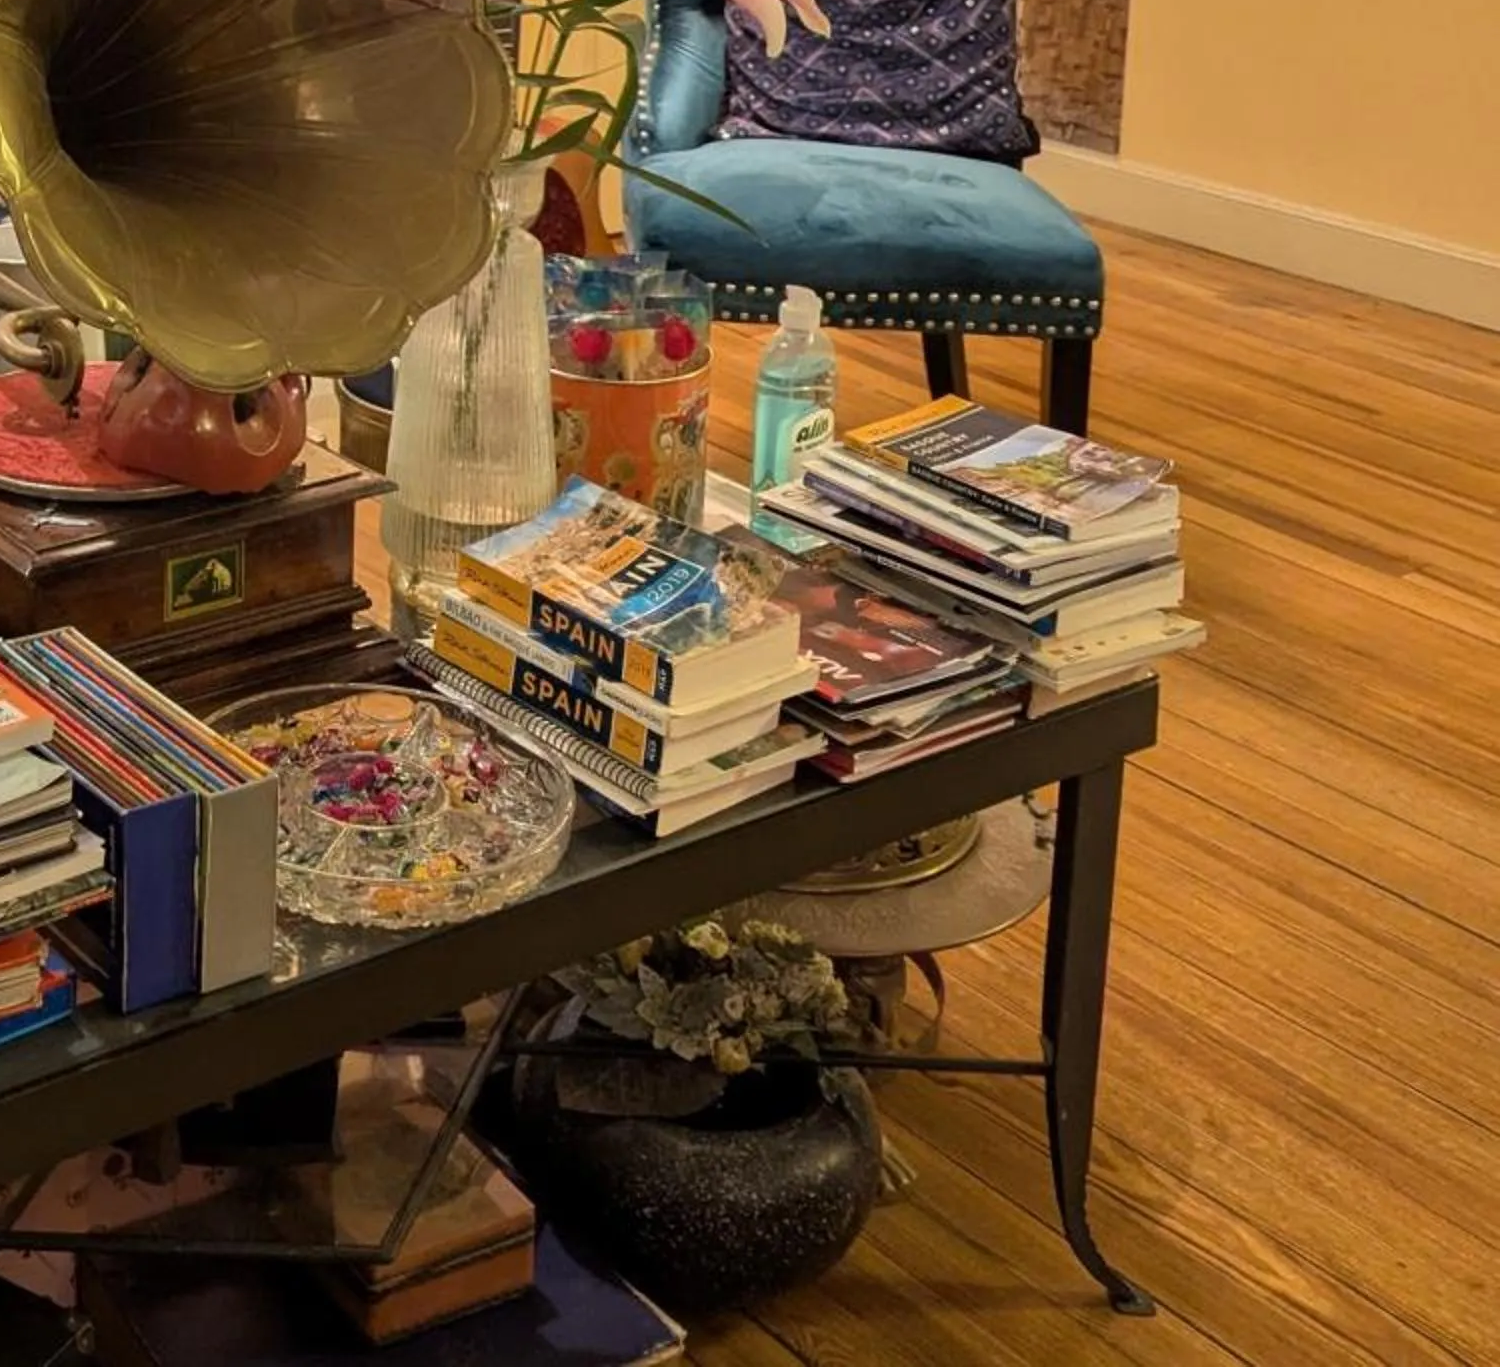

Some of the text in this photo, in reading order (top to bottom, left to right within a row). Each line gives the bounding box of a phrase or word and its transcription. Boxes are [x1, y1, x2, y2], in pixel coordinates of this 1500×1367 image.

[646, 567, 690, 604] 2019
[539, 603, 616, 663] SPAIN
[521, 671, 604, 733] SPAIN
